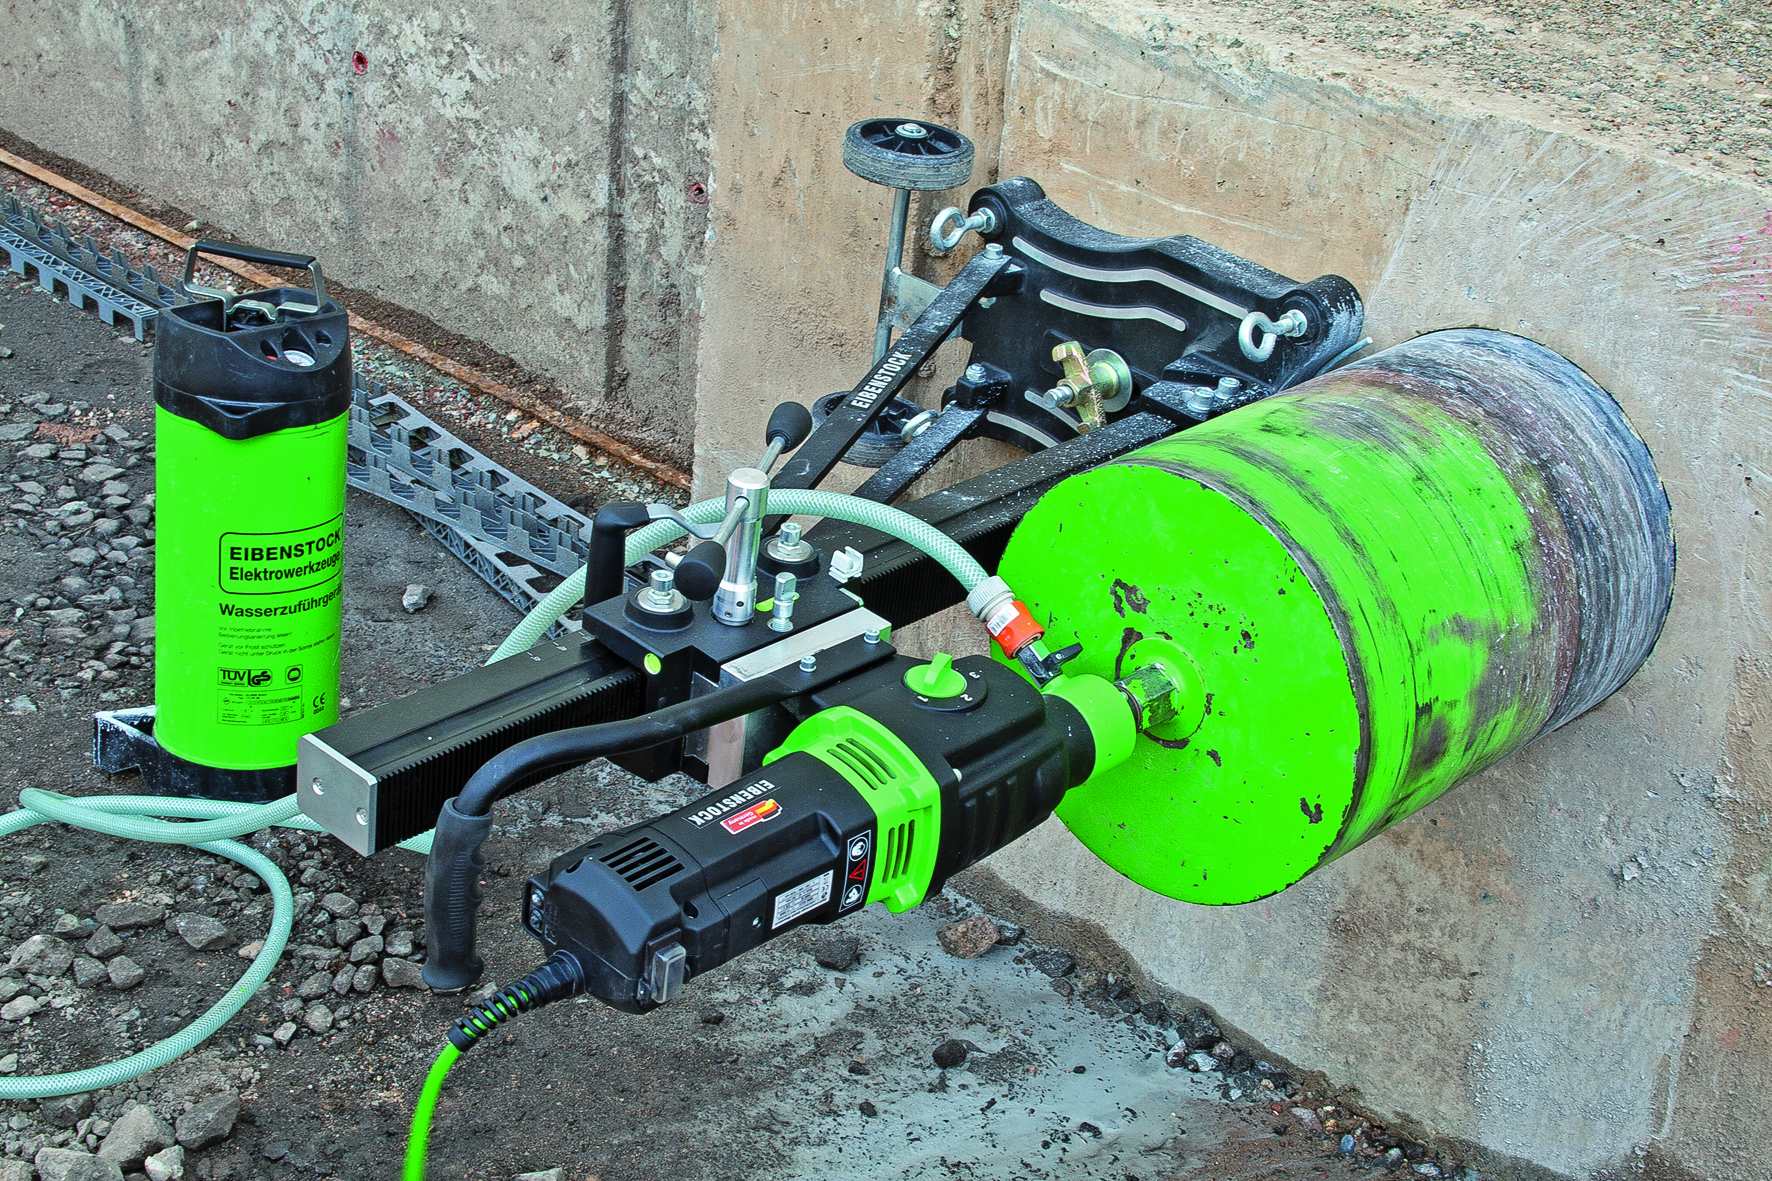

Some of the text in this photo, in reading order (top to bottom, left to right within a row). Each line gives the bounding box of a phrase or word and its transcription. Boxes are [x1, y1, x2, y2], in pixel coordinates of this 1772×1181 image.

[850, 350, 913, 409] EIBENSTOCK
[230, 527, 341, 561] EIBENSTOCK
[229, 550, 340, 581] Elektrowerkzeuge
[220, 669, 246, 681] TÜV
[969, 671, 980, 679] 3
[917, 695, 929, 703] 1
[960, 693, 973, 702] 2
[687, 779, 776, 826] EIBENSTOCK
[728, 811, 754, 826] Germany
